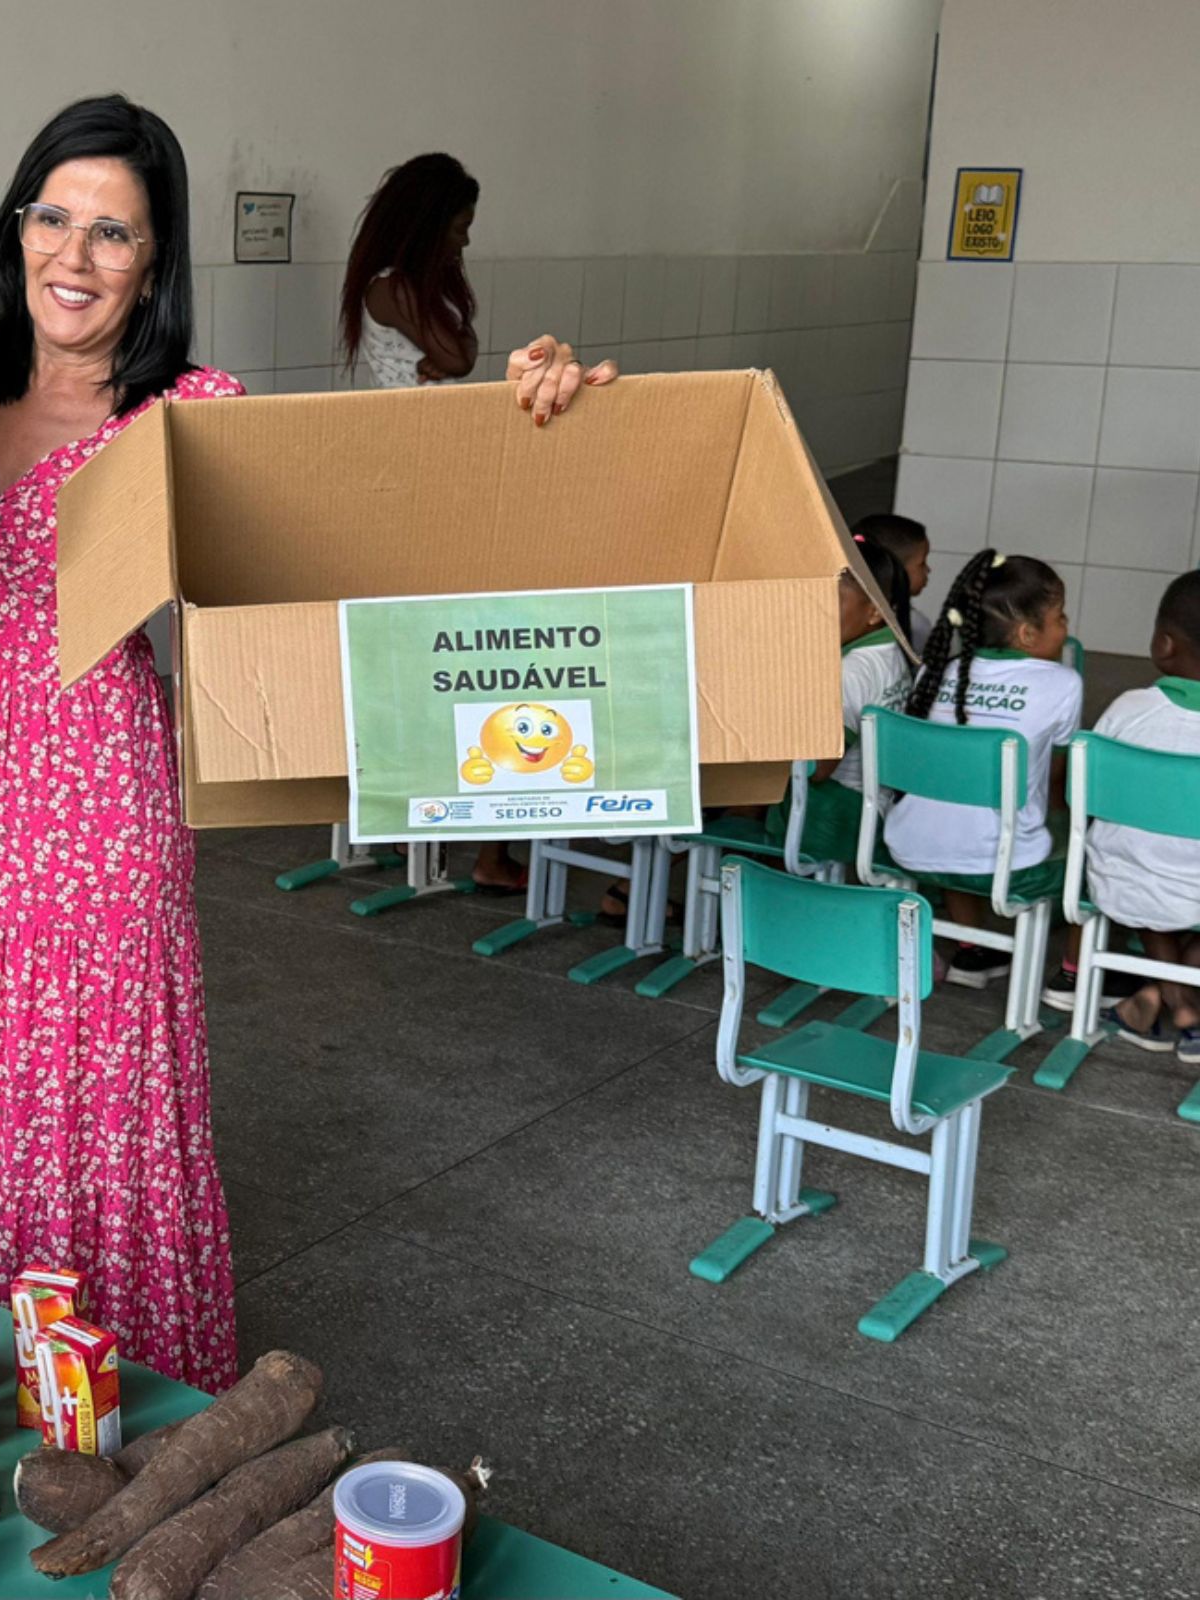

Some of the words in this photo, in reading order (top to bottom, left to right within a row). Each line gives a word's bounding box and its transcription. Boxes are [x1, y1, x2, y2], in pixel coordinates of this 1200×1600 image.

[968, 208, 998, 224] LEIO,
[966, 223, 993, 235] LOGO
[432, 626, 601, 652] ALIMENTO
[432, 663, 606, 692] SAUDÁVEL
[1009, 684, 1028, 695] DE
[586, 794, 653, 812] Feira
[495, 807, 562, 819] SEDESO
